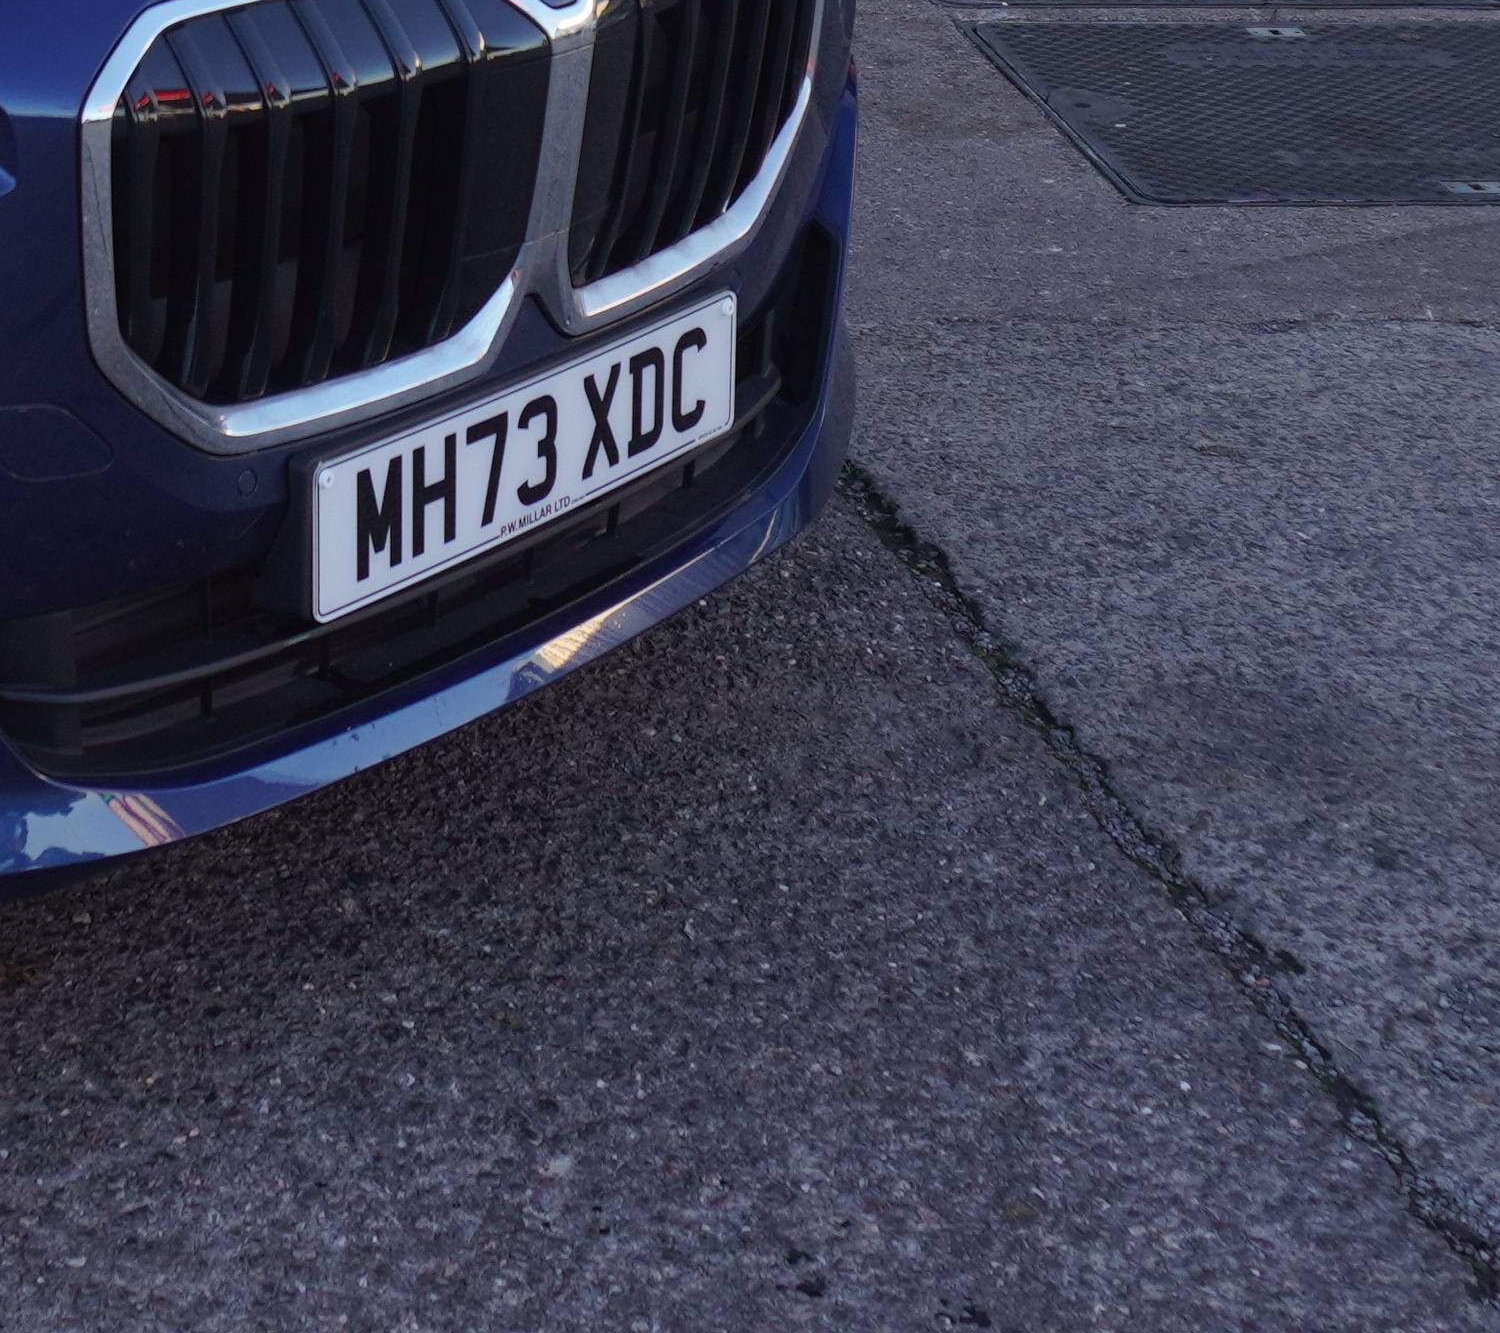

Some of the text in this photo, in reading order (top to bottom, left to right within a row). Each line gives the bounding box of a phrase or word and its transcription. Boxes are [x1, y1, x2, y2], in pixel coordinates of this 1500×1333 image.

[356, 326, 708, 583] MH73 XDC
[554, 495, 571, 513] LTD
